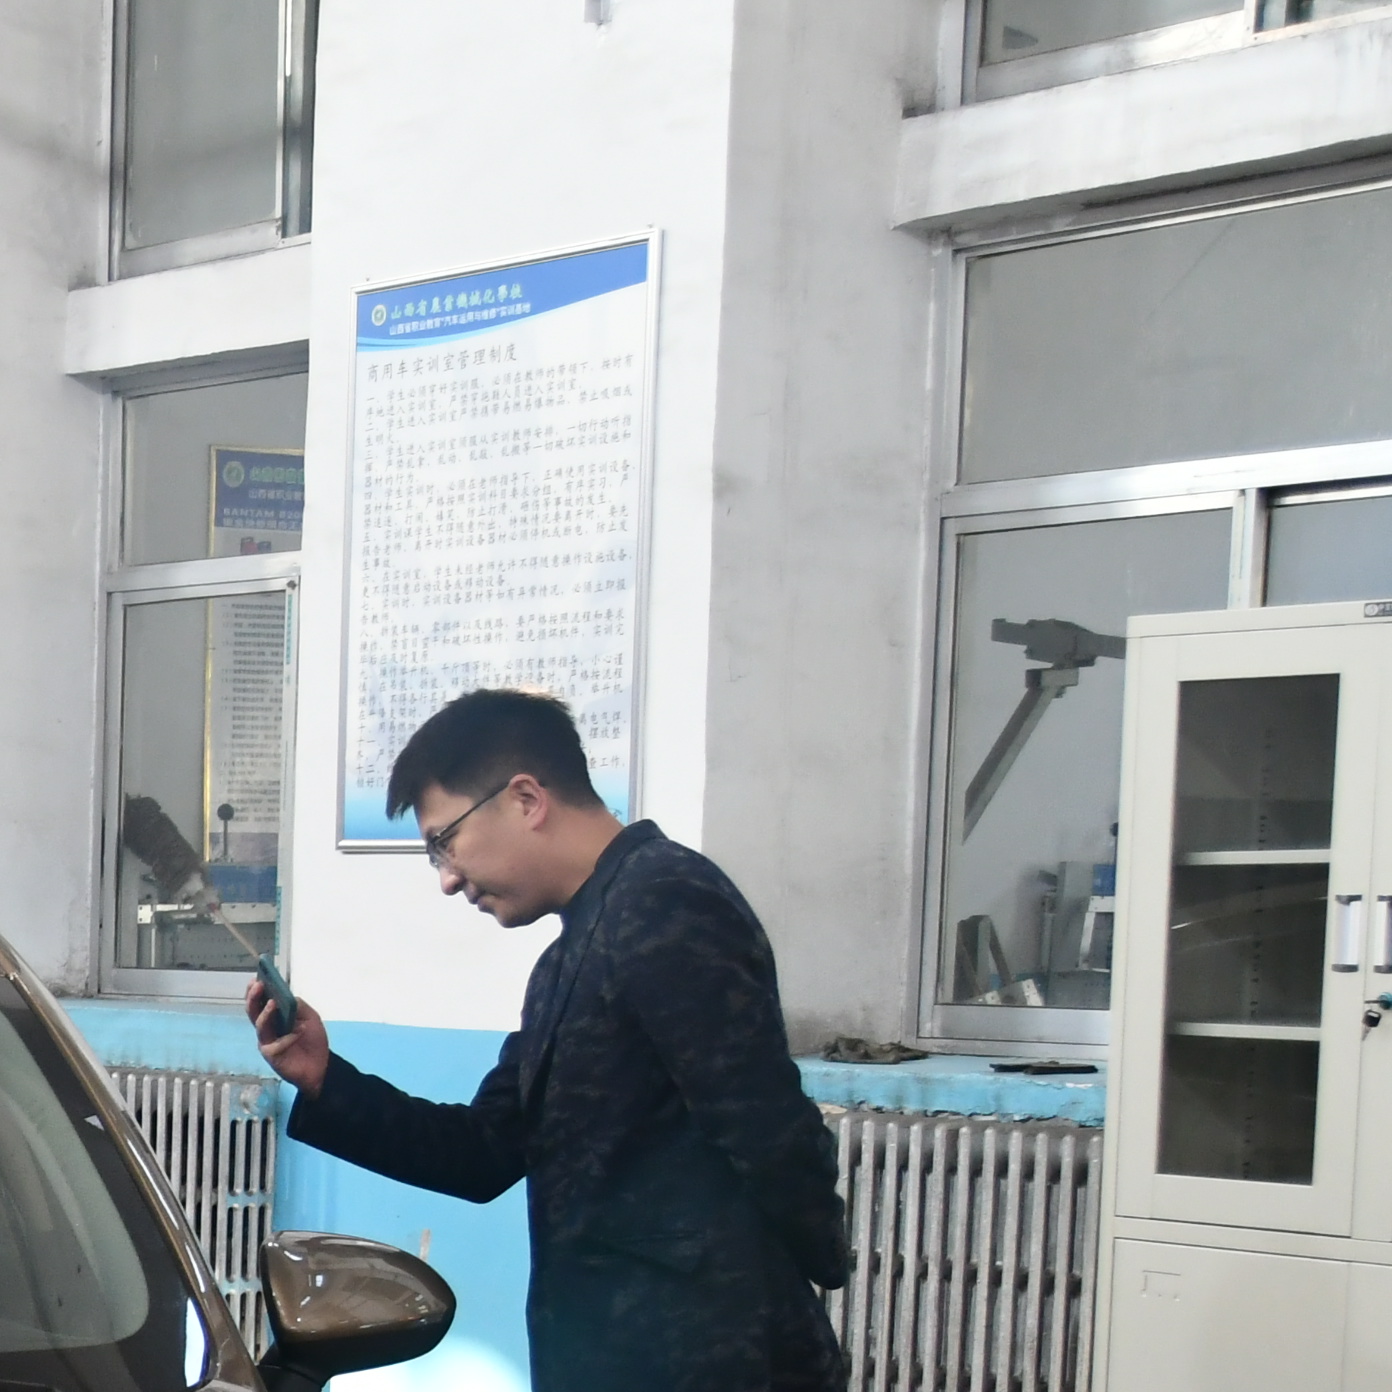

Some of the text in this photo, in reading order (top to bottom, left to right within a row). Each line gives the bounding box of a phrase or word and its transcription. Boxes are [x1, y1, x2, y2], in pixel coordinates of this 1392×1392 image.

[366, 342, 517, 384] 商用车实训室管理制度
